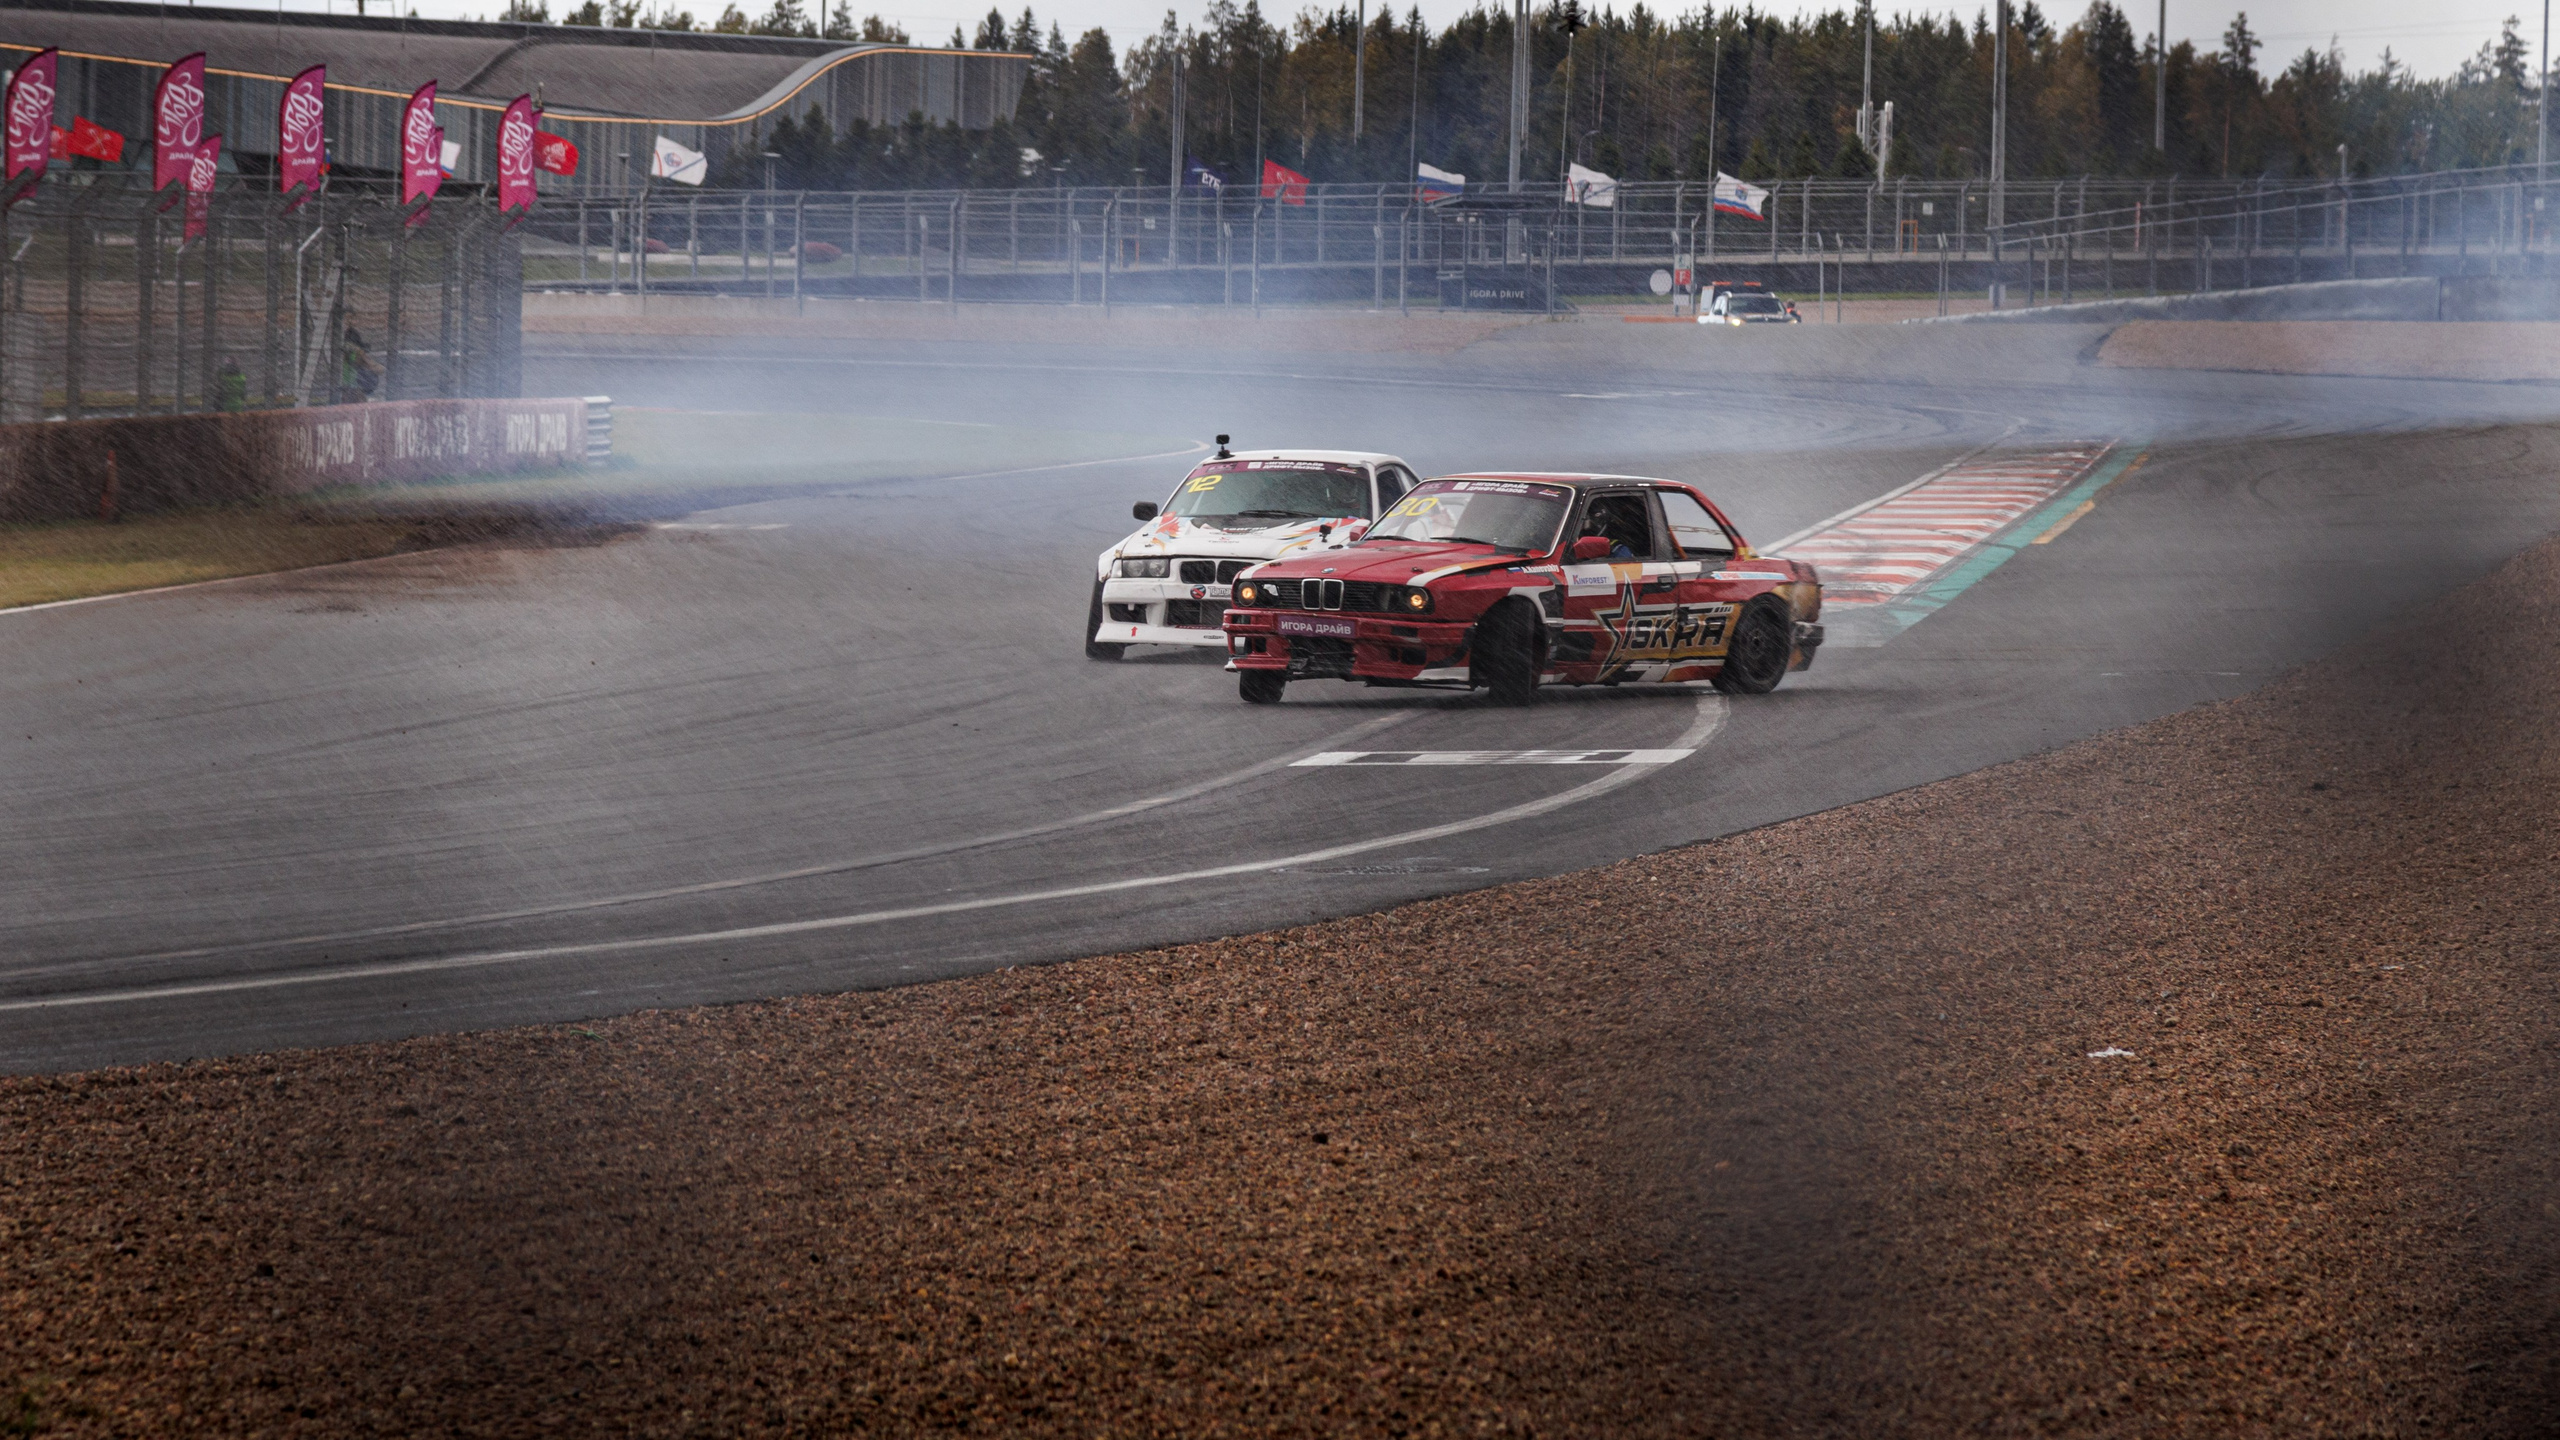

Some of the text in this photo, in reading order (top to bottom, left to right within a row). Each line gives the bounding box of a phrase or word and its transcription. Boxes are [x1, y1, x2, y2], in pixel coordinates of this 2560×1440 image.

[1470, 289, 1525, 299] IGORA DRIVE
[1186, 475, 1223, 493] 12
[1387, 498, 1439, 517] 30
[1281, 620, 1352, 635] ИГОРА ДРАЙВ
[1620, 615, 1729, 650] ISKRA
